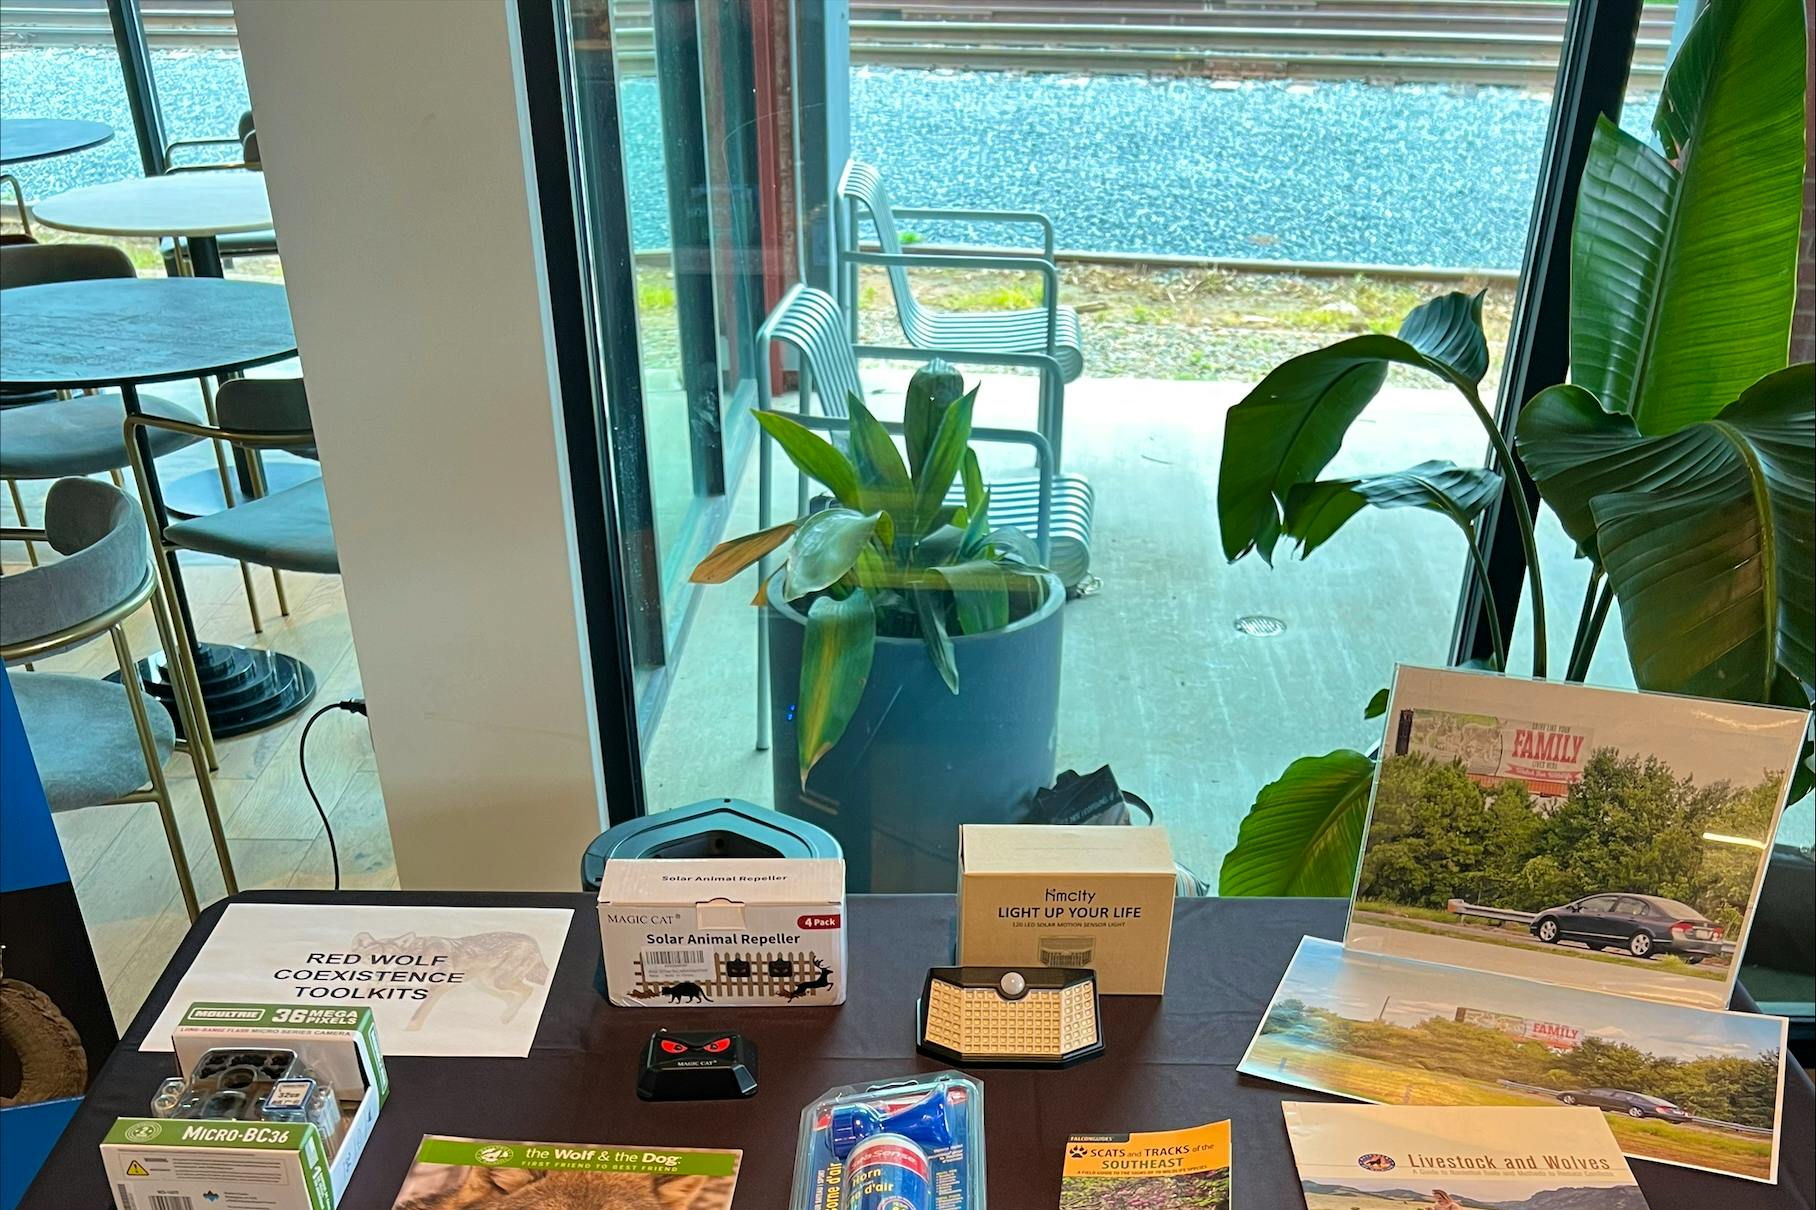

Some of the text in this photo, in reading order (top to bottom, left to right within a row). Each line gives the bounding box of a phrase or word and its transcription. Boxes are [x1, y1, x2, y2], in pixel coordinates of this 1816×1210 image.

[1512, 729, 1585, 764] FAMILY
[739, 875, 788, 883] Repeller
[607, 913, 648, 924] MAGIC
[998, 907, 1141, 919] LIGHT UP YOUR LIFE
[805, 917, 836, 927] 4 Pack
[646, 933, 800, 947] Solar Animal Repeller
[306, 953, 448, 966] RED WOLF
[274, 969, 464, 983] COEXISTENCE
[294, 986, 429, 1000] TOOLKITS
[194, 1009, 259, 1019] MOULTRIE
[271, 1008, 308, 1024] 36
[309, 1010, 358, 1018] MEGA
[306, 1017, 358, 1025] PIXELS
[1533, 1023, 1579, 1039] FAMILY
[182, 1125, 289, 1144] MICRO-BC36
[526, 1148, 550, 1159] the
[554, 1149, 595, 1161] Wolf
[598, 1150, 610, 1162] &
[614, 1151, 638, 1163] the
[1090, 1149, 1125, 1158] SCATS
[1144, 1145, 1190, 1157] TRACKS
[521, 1160, 550, 1168] FIRST
[1102, 1158, 1184, 1170] SOUTHEAST
[1408, 1153, 1497, 1170] Livestock
[1504, 1154, 1537, 1170] and
[1543, 1155, 1611, 1170] Wolves
[826, 1162, 843, 1184] d'air
[852, 1168, 881, 1187] Horn
[864, 1182, 894, 1195] d'air
